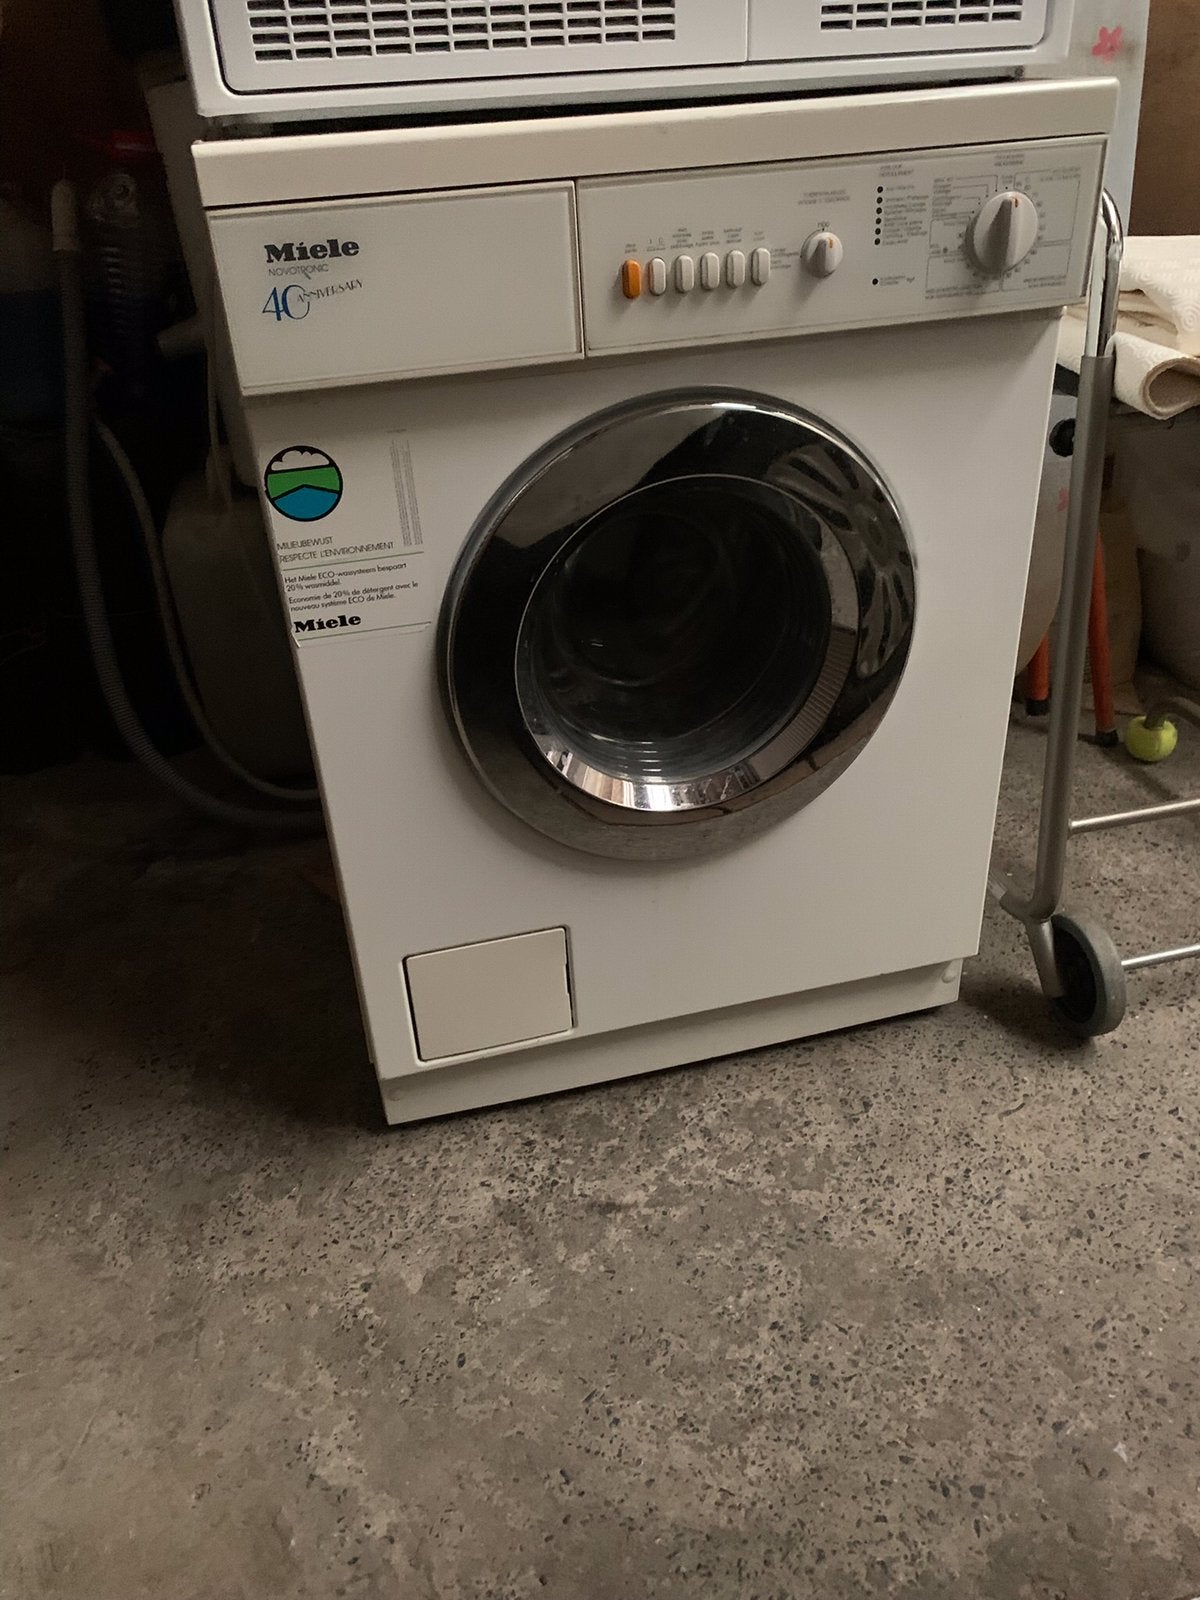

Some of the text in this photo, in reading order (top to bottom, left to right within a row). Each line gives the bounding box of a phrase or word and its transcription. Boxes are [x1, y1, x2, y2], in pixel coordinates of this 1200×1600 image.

[264, 239, 360, 263] Miele
[268, 264, 329, 278] NOVOTRONIC
[297, 279, 364, 303] ANNIVERSARY
[262, 284, 310, 321] 40
[276, 536, 333, 550] MILIEUBEWUST
[280, 541, 394, 563] RESPECTE L'ENVIRONNEMENT
[298, 574, 317, 582] Miele
[322, 592, 332, 600] de
[352, 588, 361, 596] de
[412, 580, 419, 588] le
[290, 604, 320, 612] nouveau
[348, 595, 365, 605] ECO
[366, 594, 375, 602] de
[293, 614, 362, 633] Miele
